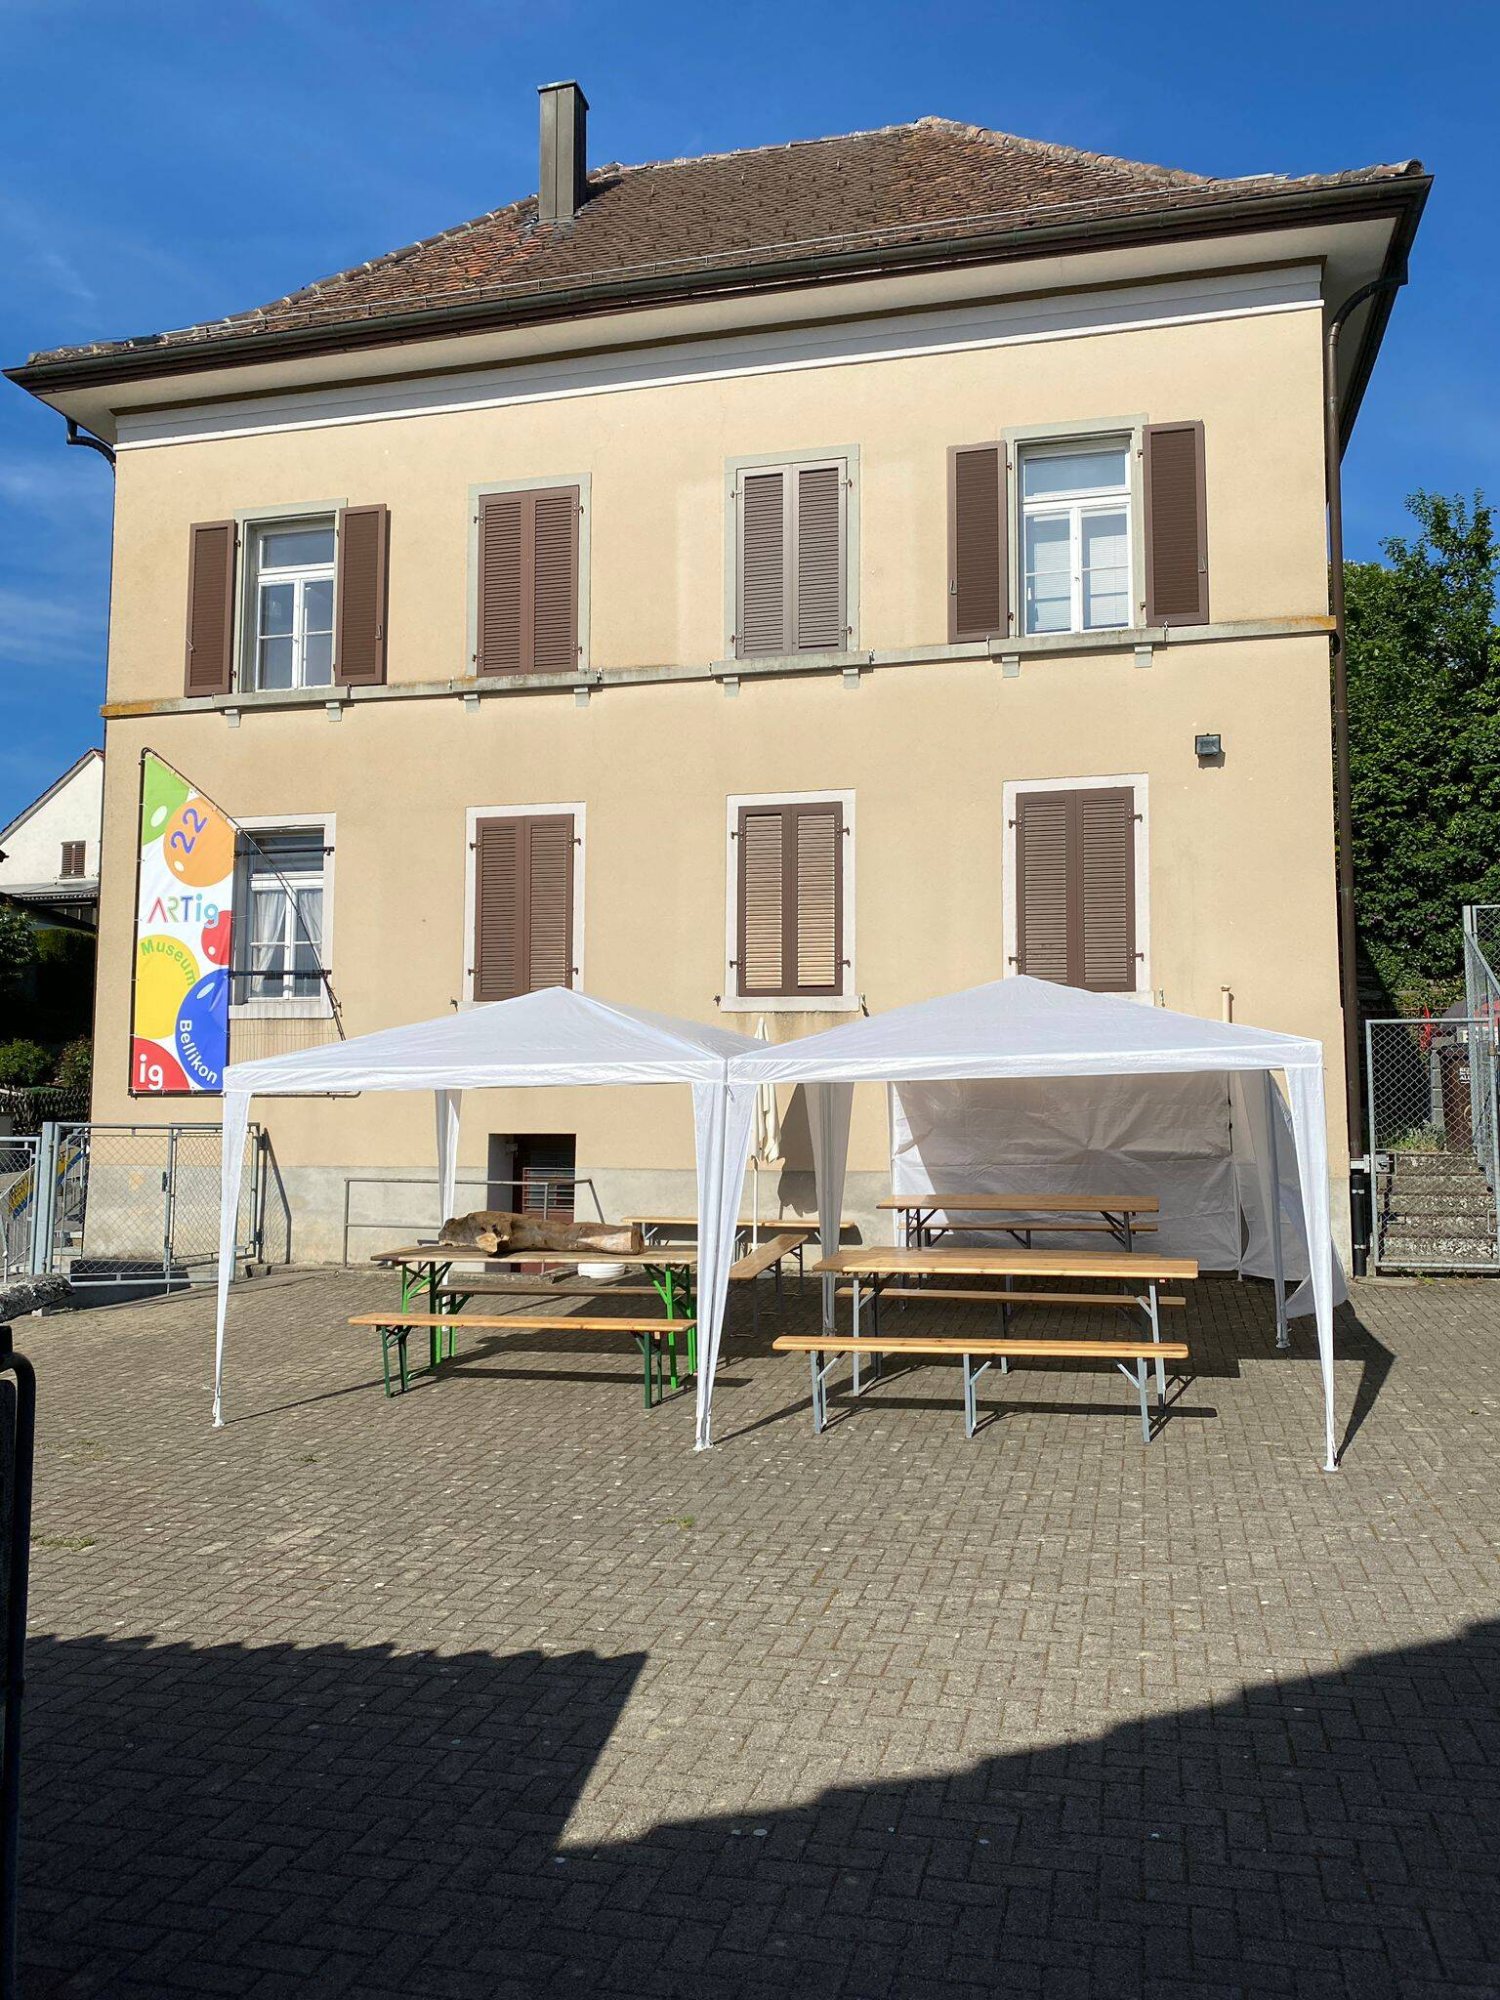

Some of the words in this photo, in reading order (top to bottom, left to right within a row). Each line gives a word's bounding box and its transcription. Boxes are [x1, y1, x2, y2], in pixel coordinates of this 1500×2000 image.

[170, 807, 208, 854] 22
[146, 893, 219, 929] ARTig
[140, 939, 197, 986] Museum
[139, 1053, 164, 1091] ig
[179, 1019, 218, 1085] Bellikon
